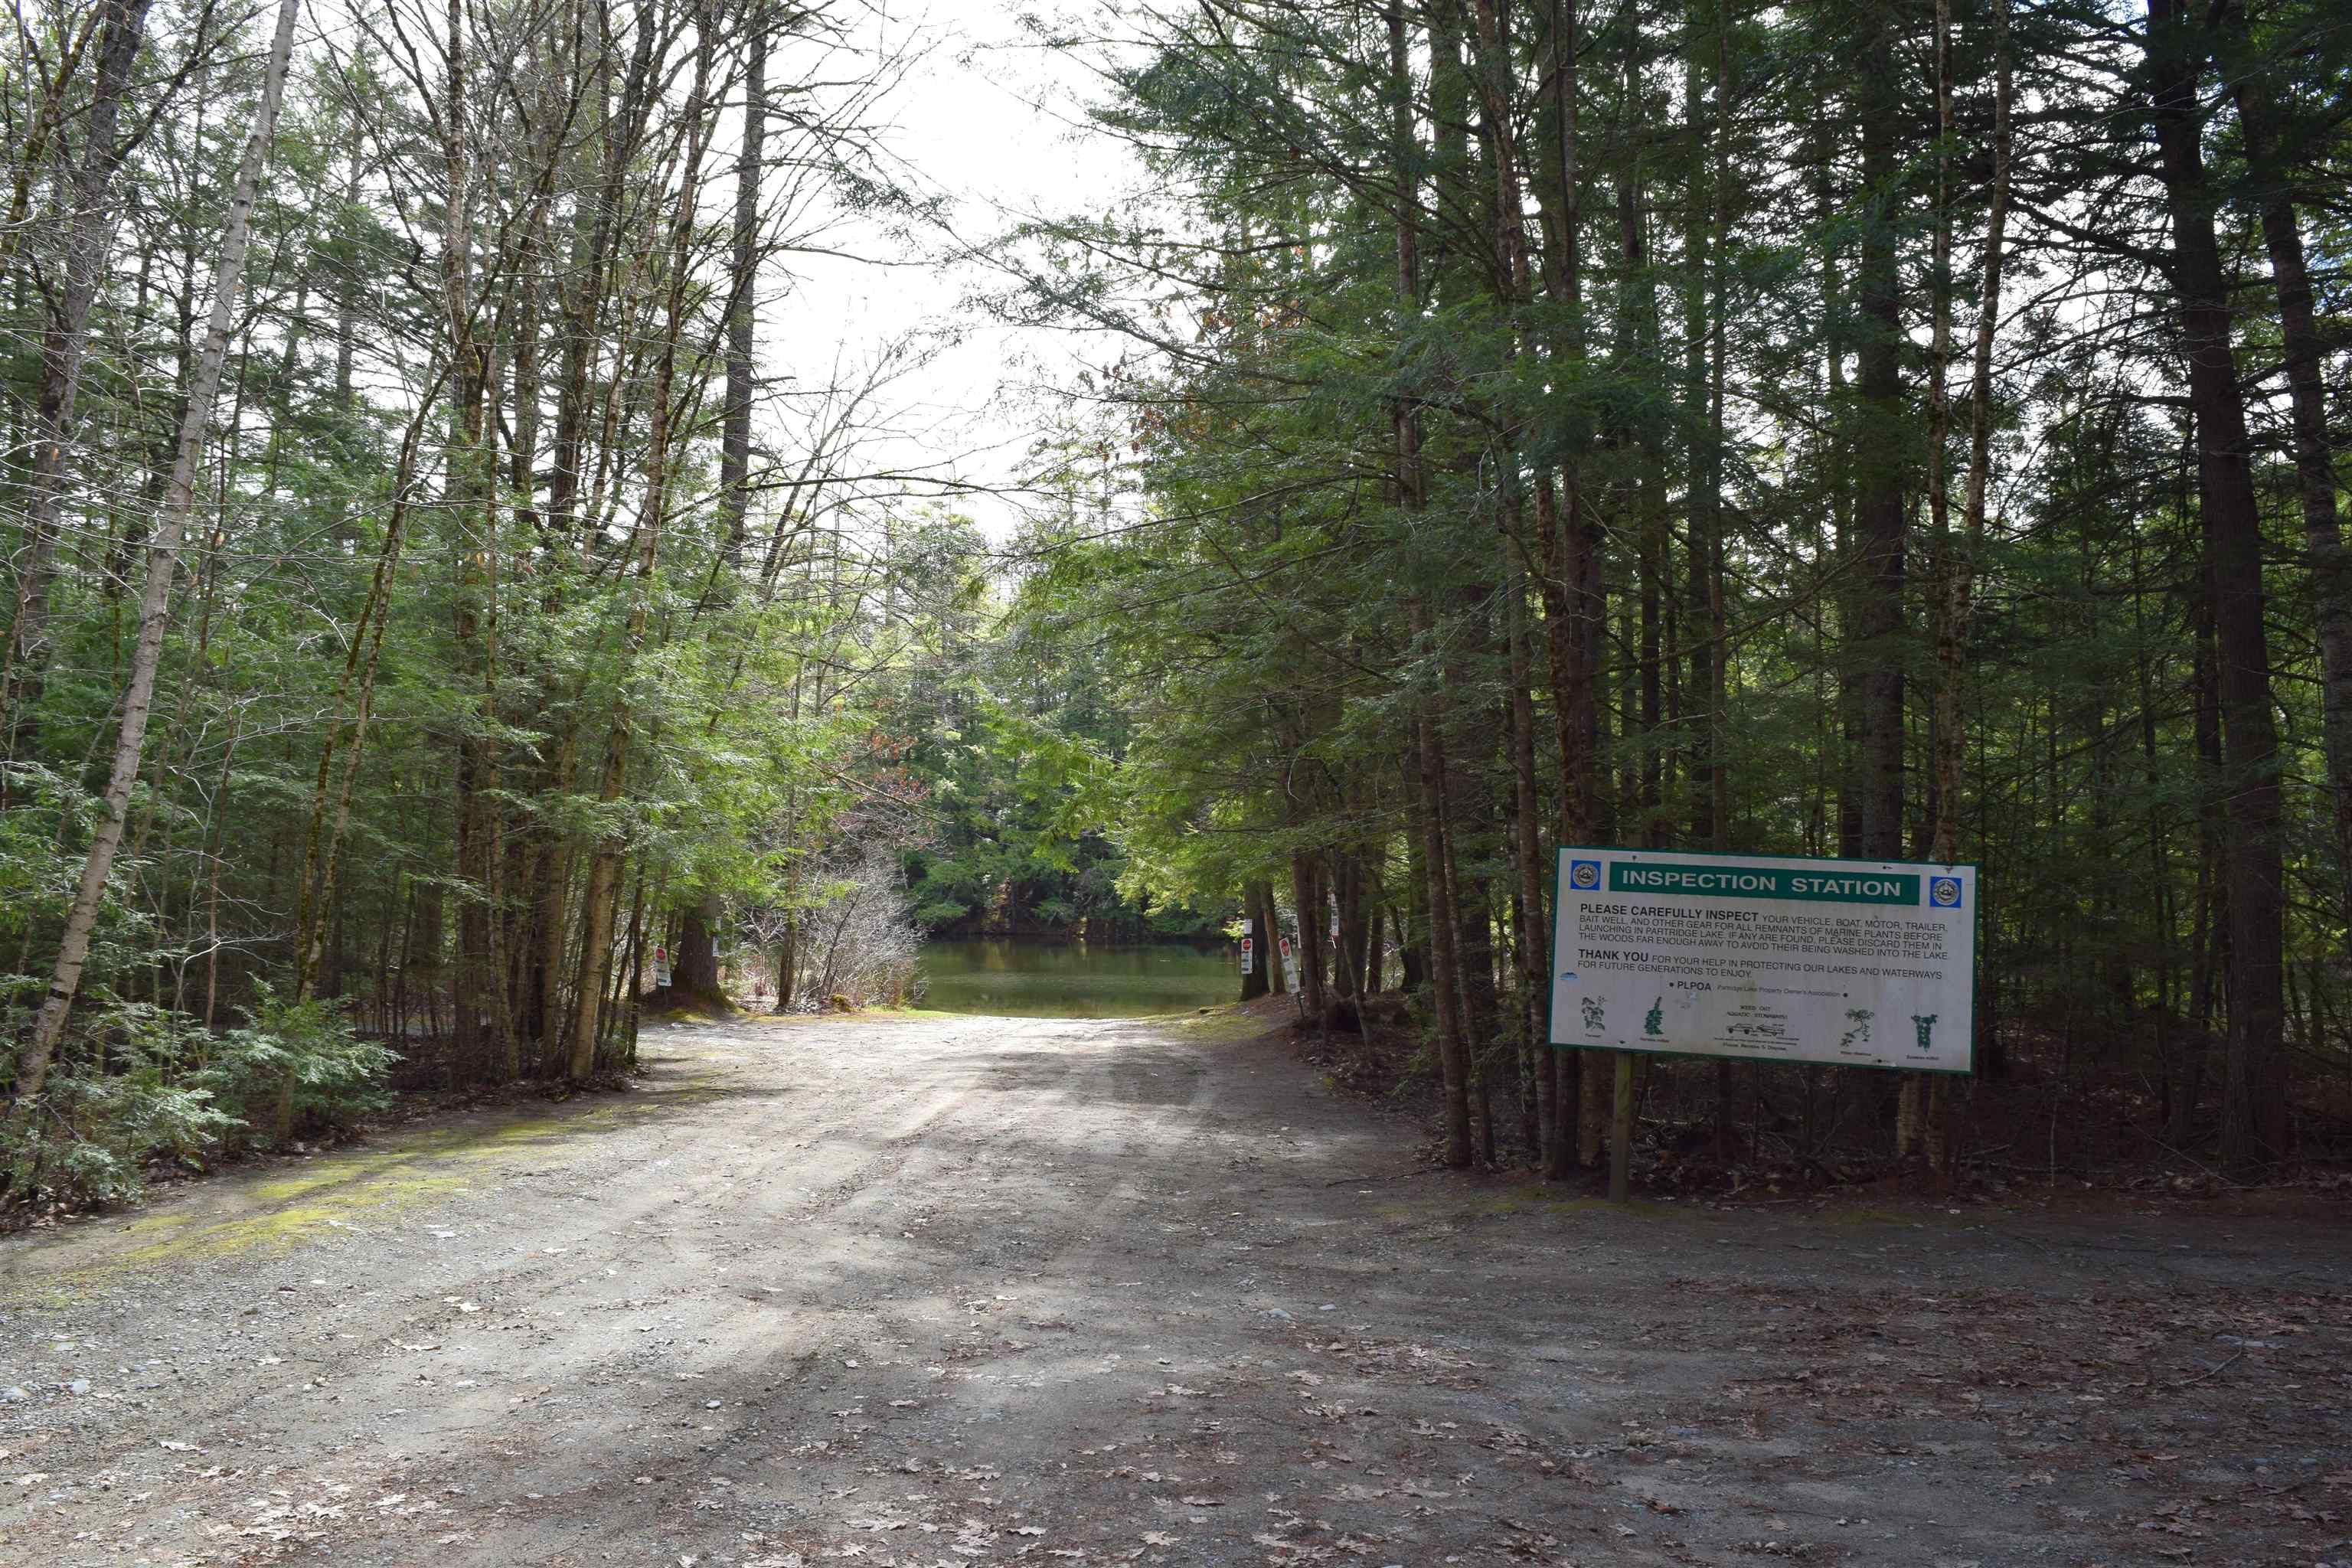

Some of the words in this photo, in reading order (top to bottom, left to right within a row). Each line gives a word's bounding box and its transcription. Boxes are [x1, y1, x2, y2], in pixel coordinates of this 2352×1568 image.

[1622, 869, 1776, 891] INSPECTION
[1791, 877, 1902, 897] STATION
[1580, 903, 1627, 915] PLEASE
[1631, 906, 1702, 919] CAREFULLY
[1706, 910, 1759, 922] INSPECT
[1762, 915, 1789, 924] YOUR
[1579, 915, 1599, 923] BAIT
[1631, 918, 1650, 926] AND
[1651, 918, 1684, 928] OTHER
[1686, 920, 1712, 929] GEAR
[1714, 921, 1734, 930] FOR
[1736, 923, 1752, 932] ALL
[1755, 924, 1807, 935] REMNANTS
[1809, 926, 1822, 935] OF
[1824, 927, 1863, 937] MARINE
[1864, 929, 1900, 939] PLANTS
[1903, 932, 1942, 941] BEFORE
[1579, 924, 1632, 934] LAUNCHING
[1635, 926, 1643, 934] IN
[1646, 926, 1697, 937] PARTRIDGE
[1729, 931, 1737, 939] IF
[1738, 932, 1758, 940] ANY
[1759, 933, 1778, 942] ARE
[1818, 936, 1855, 946] PLEASE
[1857, 938, 1900, 948] DISCARD
[1903, 940, 1929, 949] THEM
[1932, 942, 1942, 950] IN
[1579, 933, 1597, 941] THE
[1599, 933, 1634, 943] WOODS
[1636, 936, 1654, 944] FAR
[1656, 936, 1696, 946] ENOUGH
[1699, 939, 1723, 948] AWAY
[1726, 940, 1739, 949] TO
[1740, 942, 1769, 950] AVOID
[1771, 942, 1799, 952] THEIR
[1802, 944, 1831, 954] BEING
[1833, 946, 1874, 956] WASHED
[1877, 949, 1900, 958] INTO
[1902, 950, 1921, 959] THE
[1578, 960, 1596, 969] FOR
[1599, 961, 1636, 971] FUTURE
[1638, 964, 1704, 975] GENERATIONS
[1706, 968, 1718, 976] TO
[1720, 969, 1752, 978] ENJOY.
[1579, 949, 1619, 960] THANK
[1622, 951, 1648, 962] YOU
[1651, 955, 1672, 963] FOR
[1673, 956, 1700, 965] YOUR
[1702, 959, 1726, 967] HELP
[1729, 959, 1738, 968] IN
[1740, 960, 1802, 971] PROTECTING
[1803, 963, 1824, 972] OUR
[1827, 965, 1857, 975] LAKES
[1882, 969, 1942, 979] WATERWAYS
[1677, 981, 1712, 991] PLPOA
